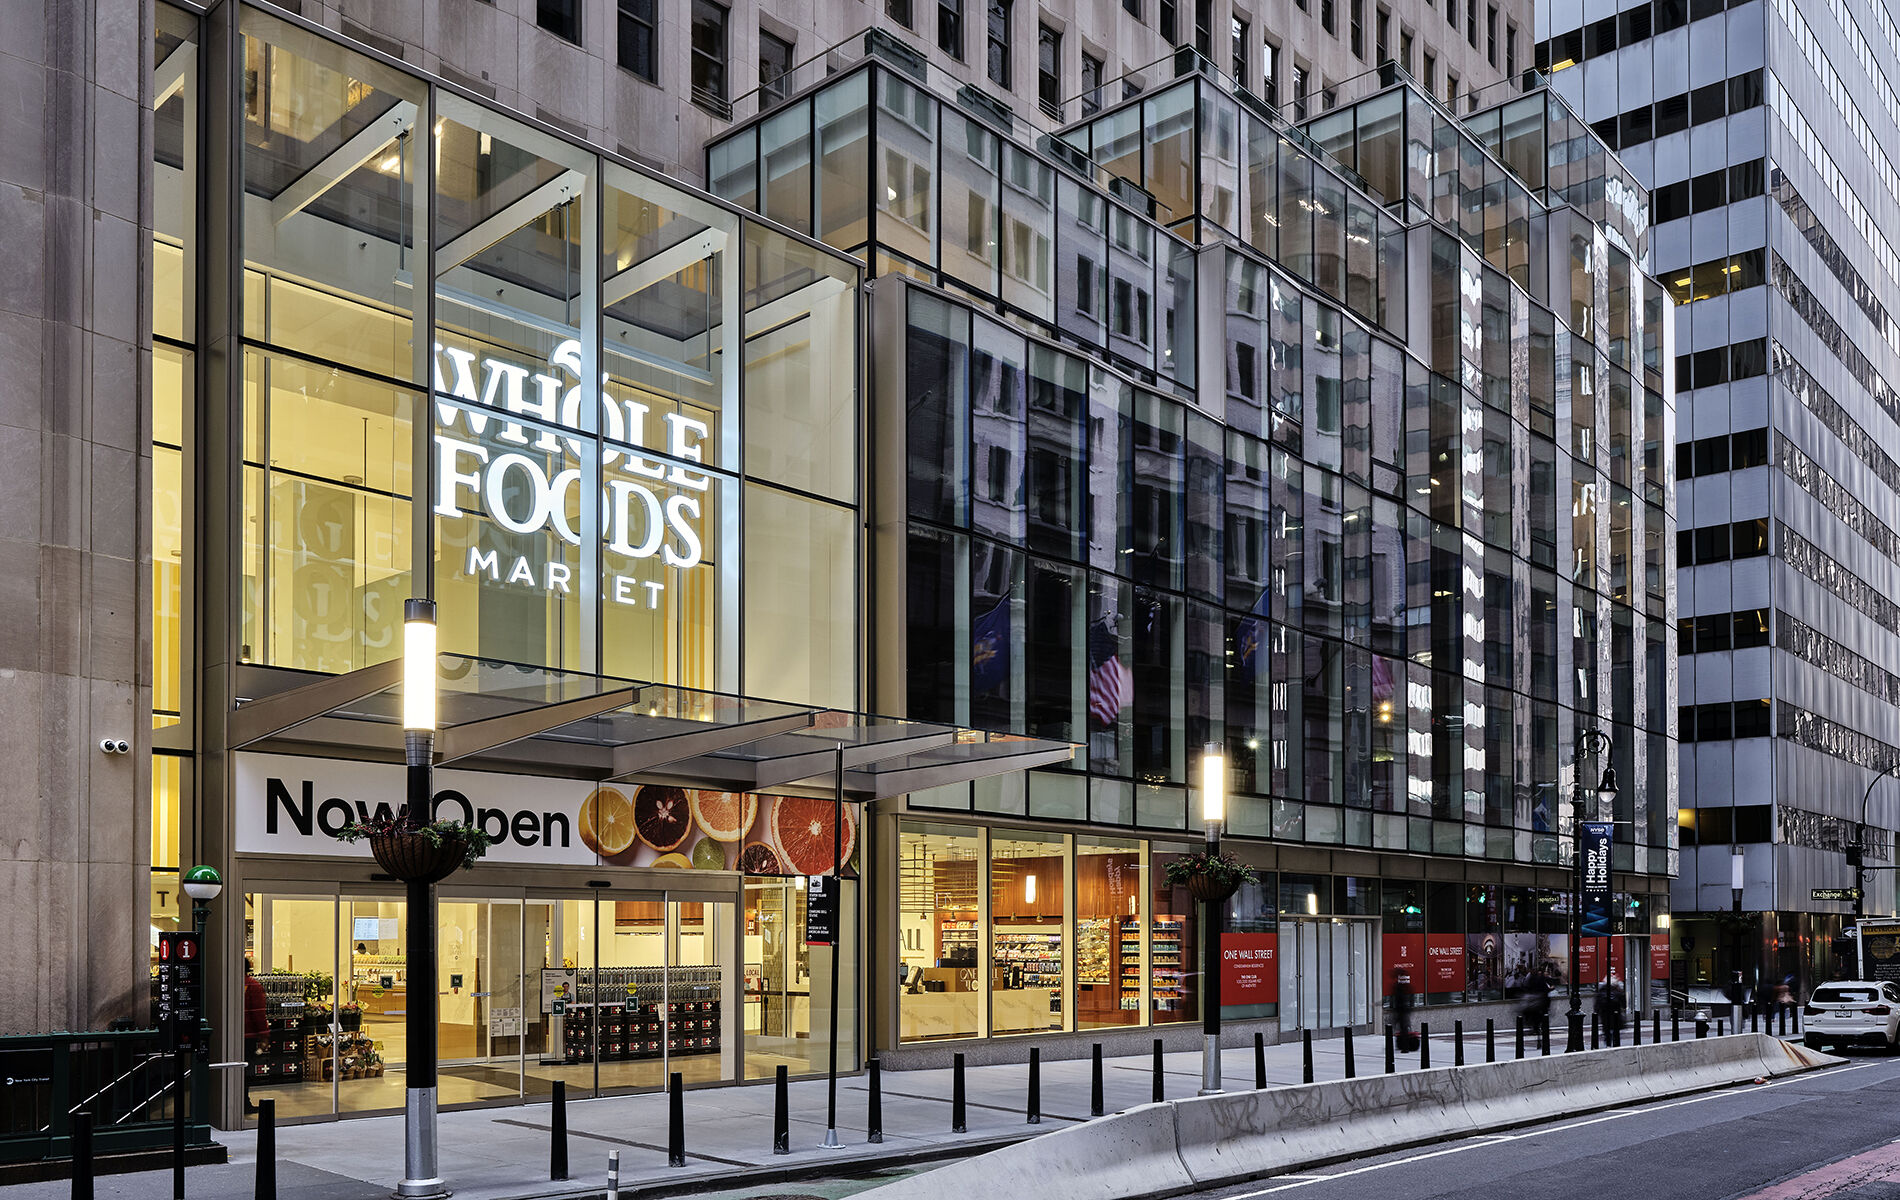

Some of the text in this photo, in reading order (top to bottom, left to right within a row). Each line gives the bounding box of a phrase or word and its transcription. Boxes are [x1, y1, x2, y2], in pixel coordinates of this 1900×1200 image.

[434, 340, 709, 492] WHOLE
[434, 434, 702, 569] FOODS
[464, 546, 665, 610] MARET
[1586, 849, 1598, 883] Happy
[1597, 838, 1609, 883] Holidays
[1812, 890, 1841, 899] Exchange
[1224, 950, 1273, 960] ONE WALL STREET
[1429, 947, 1462, 955] ONE WALL STREET
